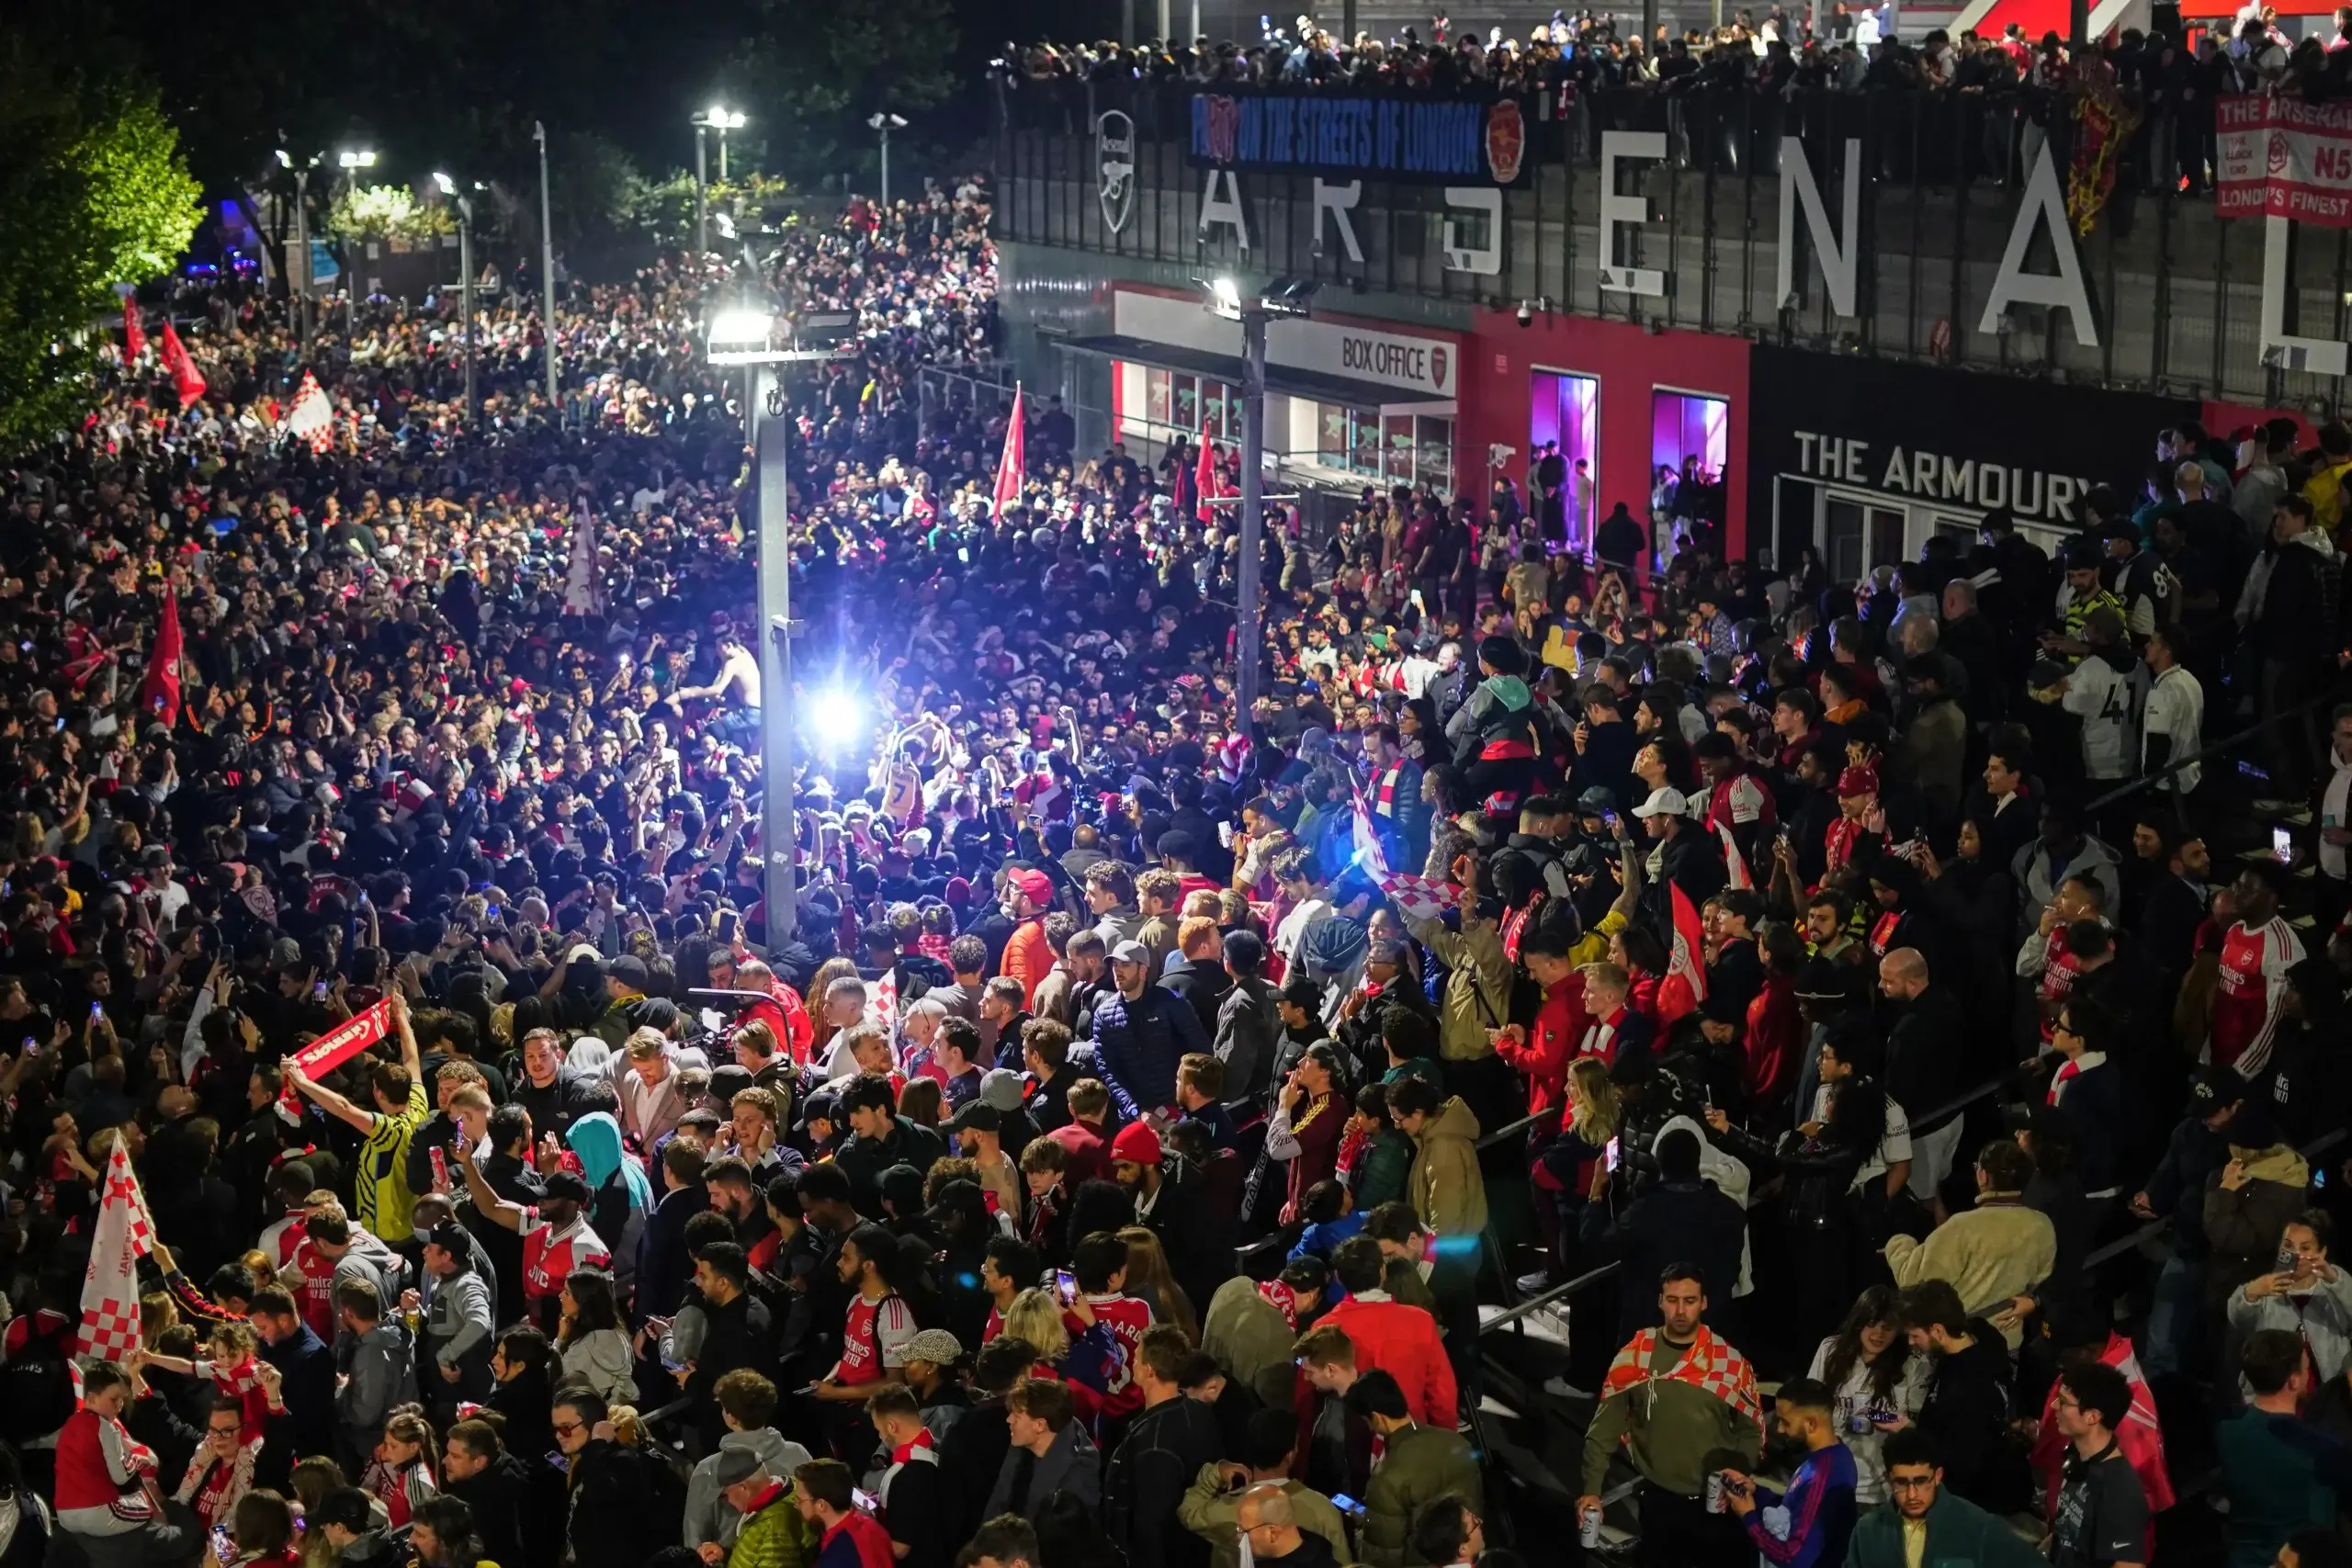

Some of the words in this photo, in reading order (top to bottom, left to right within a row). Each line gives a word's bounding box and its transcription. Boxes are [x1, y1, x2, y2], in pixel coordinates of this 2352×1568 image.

[2221, 100, 2261, 123] THE
[1265, 97, 1295, 163] THE
[1296, 98, 1373, 167] STREETS
[1377, 99, 1400, 169] OF
[1403, 101, 1482, 174] LONDON
[2290, 191, 2349, 217] FINEST
[1343, 336, 1373, 373] BOX
[1376, 341, 1426, 380] OFFICE
[1793, 430, 1869, 483] THE
[2099, 682, 2136, 725] 41
[893, 782, 906, 804] 7
[527, 1264, 549, 1288] JVC
